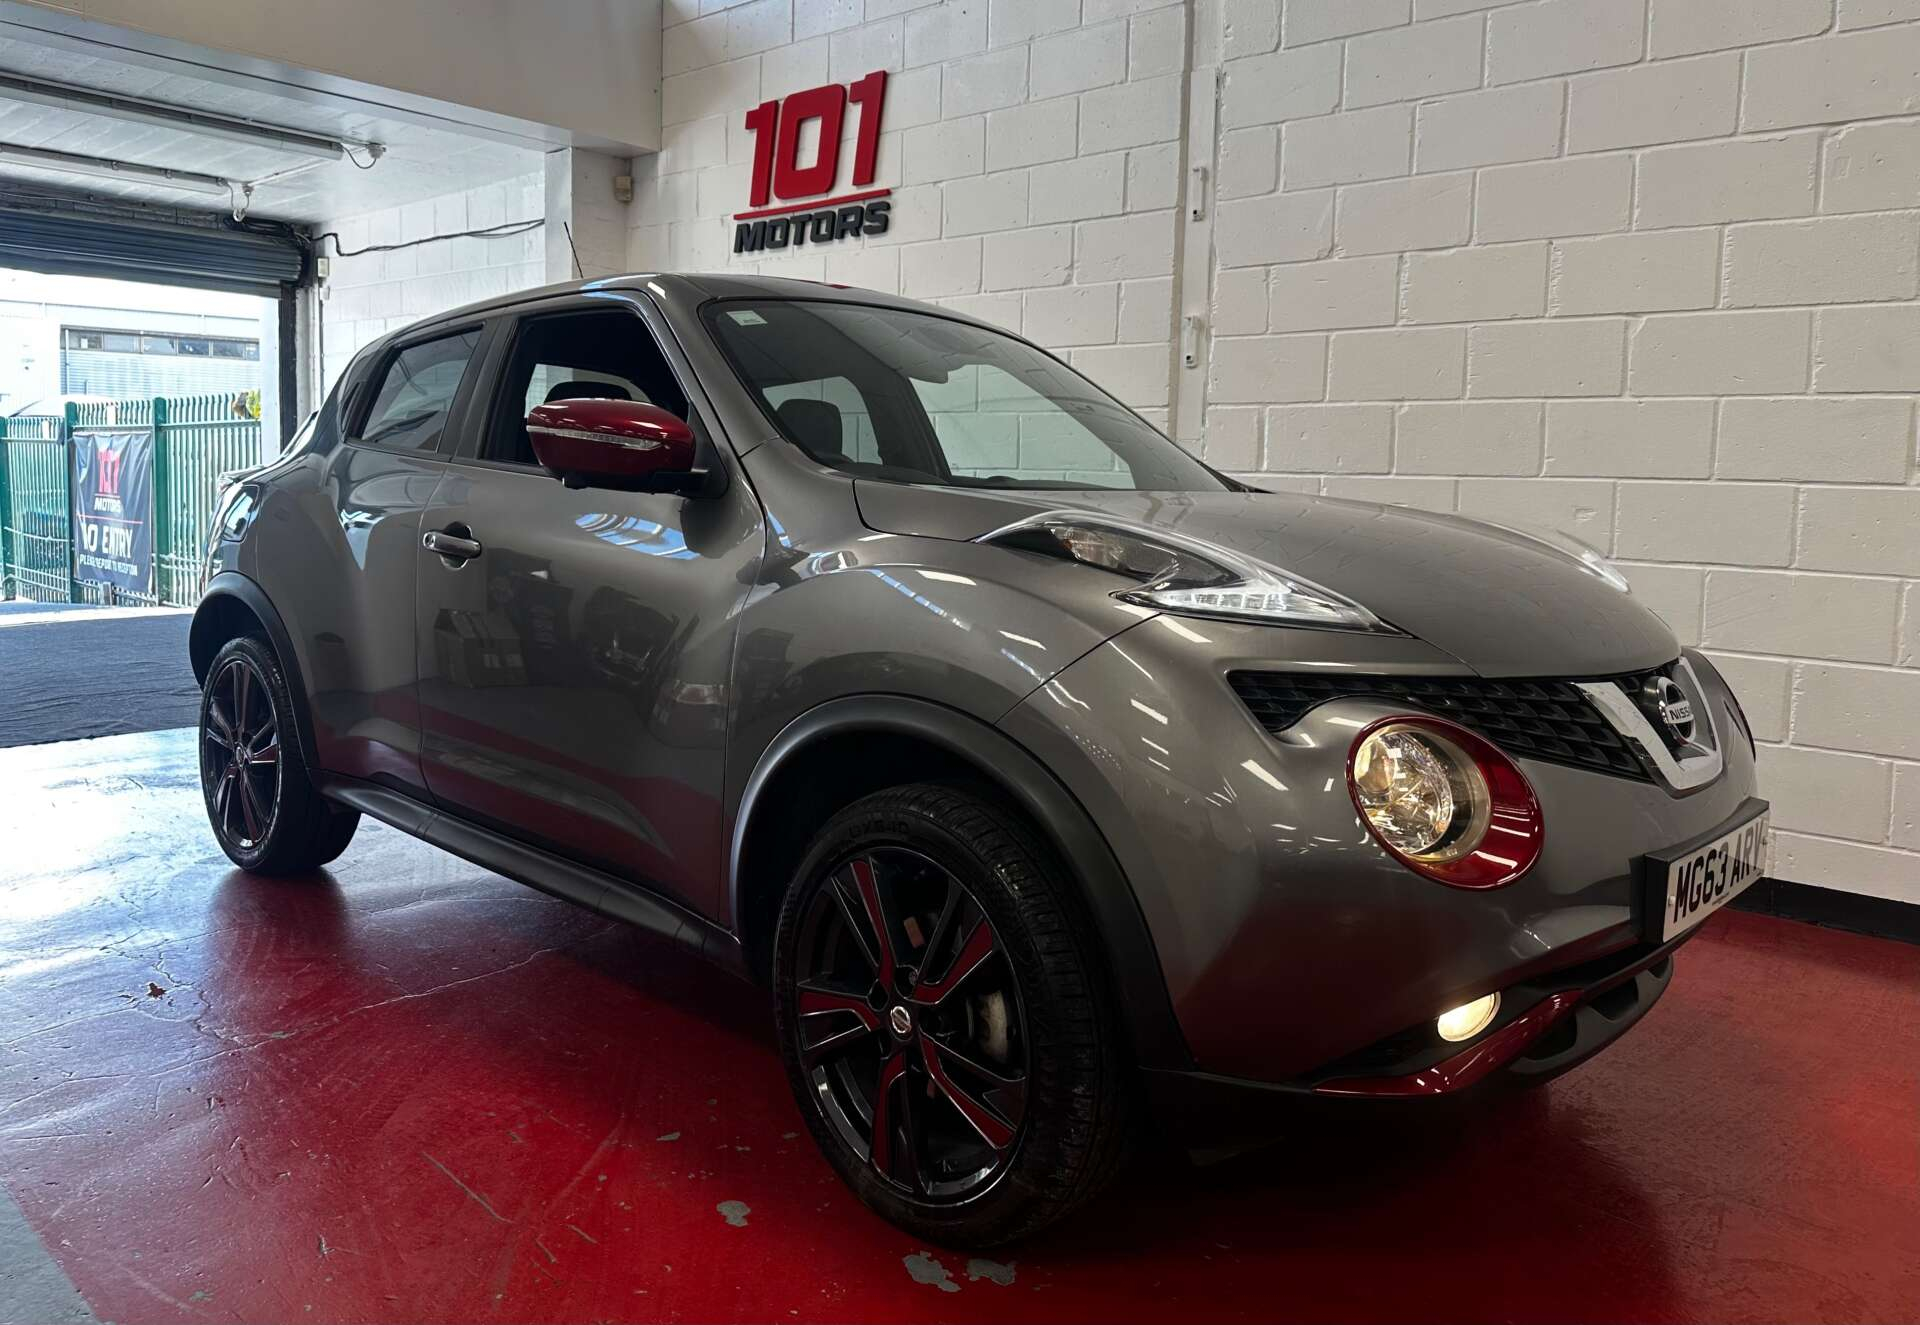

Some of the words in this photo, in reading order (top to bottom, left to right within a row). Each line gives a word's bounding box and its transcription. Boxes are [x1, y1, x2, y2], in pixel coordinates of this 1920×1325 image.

[745, 70, 888, 207] 101
[734, 201, 891, 253] MOTORS
[97, 449, 121, 494] 101
[102, 525, 133, 559] ENTRY
[1669, 706, 1690, 720] NISS
[1673, 842, 1729, 924] MG63
